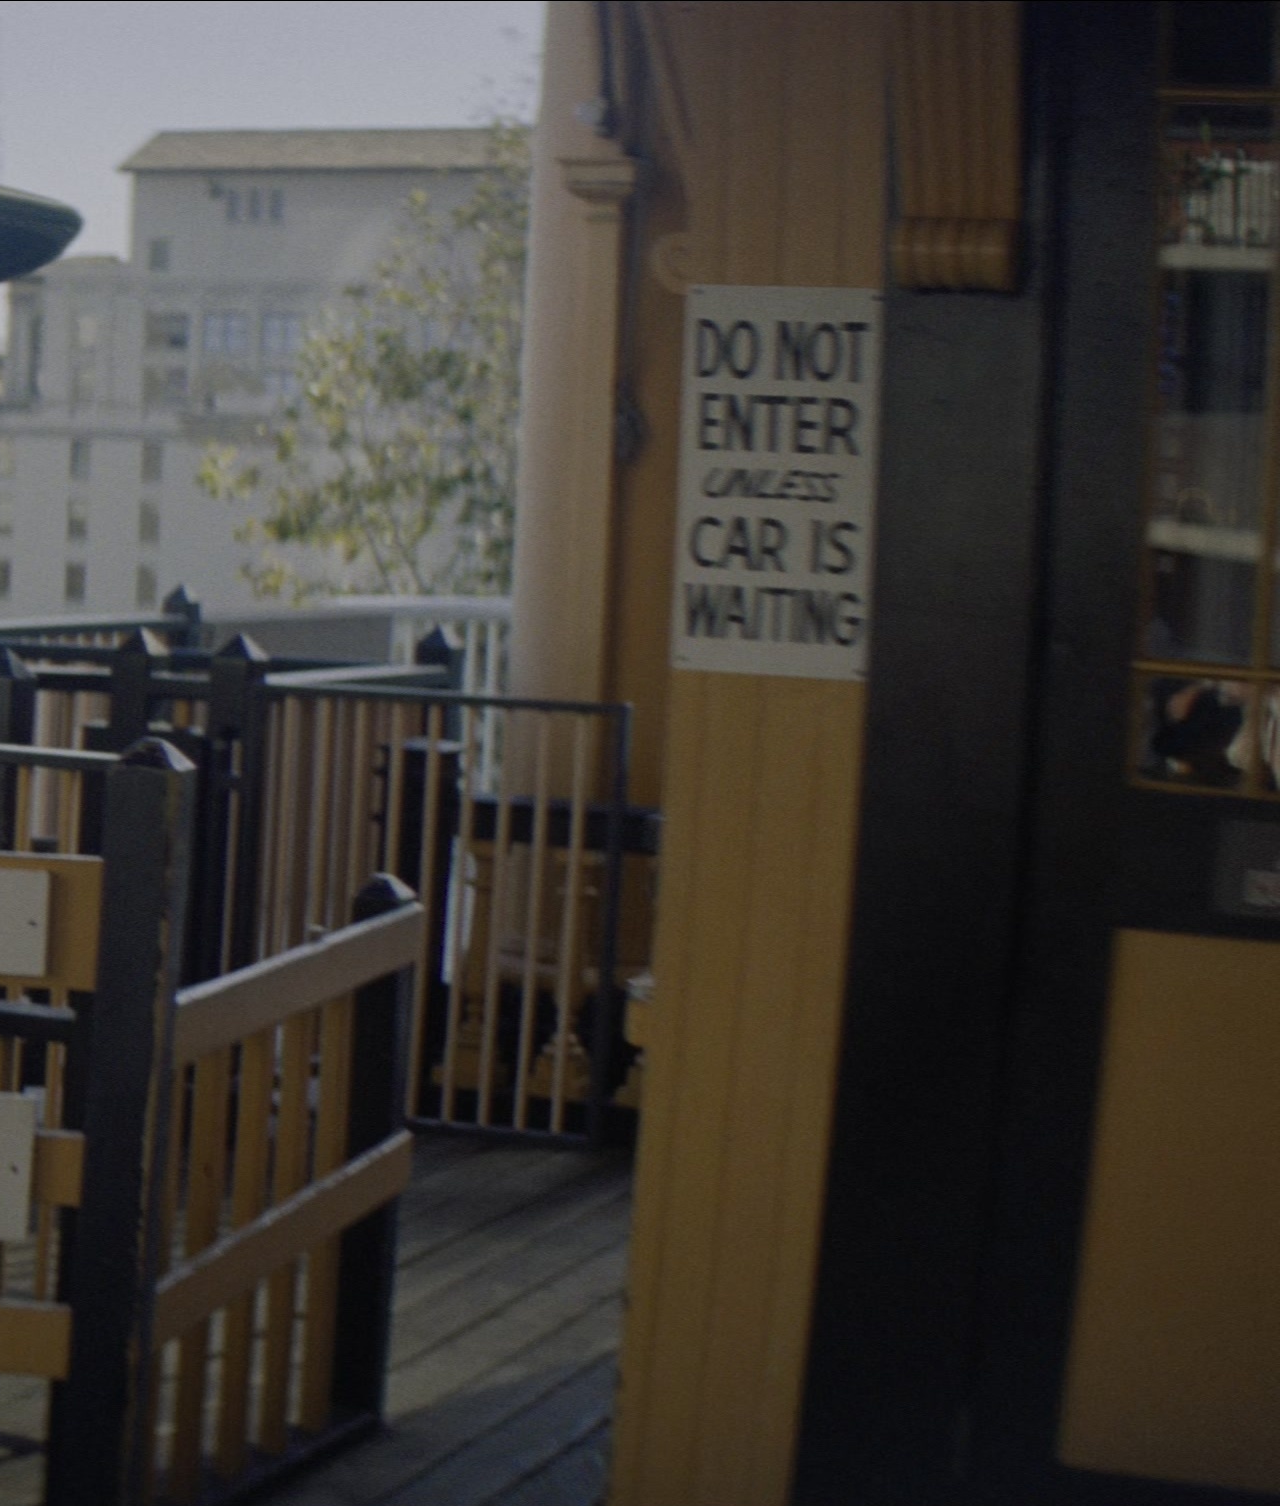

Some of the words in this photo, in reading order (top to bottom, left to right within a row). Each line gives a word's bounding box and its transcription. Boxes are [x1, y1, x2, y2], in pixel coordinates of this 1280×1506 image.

[694, 318, 760, 379] DO
[774, 321, 869, 382] NOT
[696, 393, 859, 456] ENTER
[702, 467, 842, 502] UNLESS
[689, 516, 789, 573] CAR
[811, 520, 859, 575] IS
[684, 583, 866, 647] WAITING
